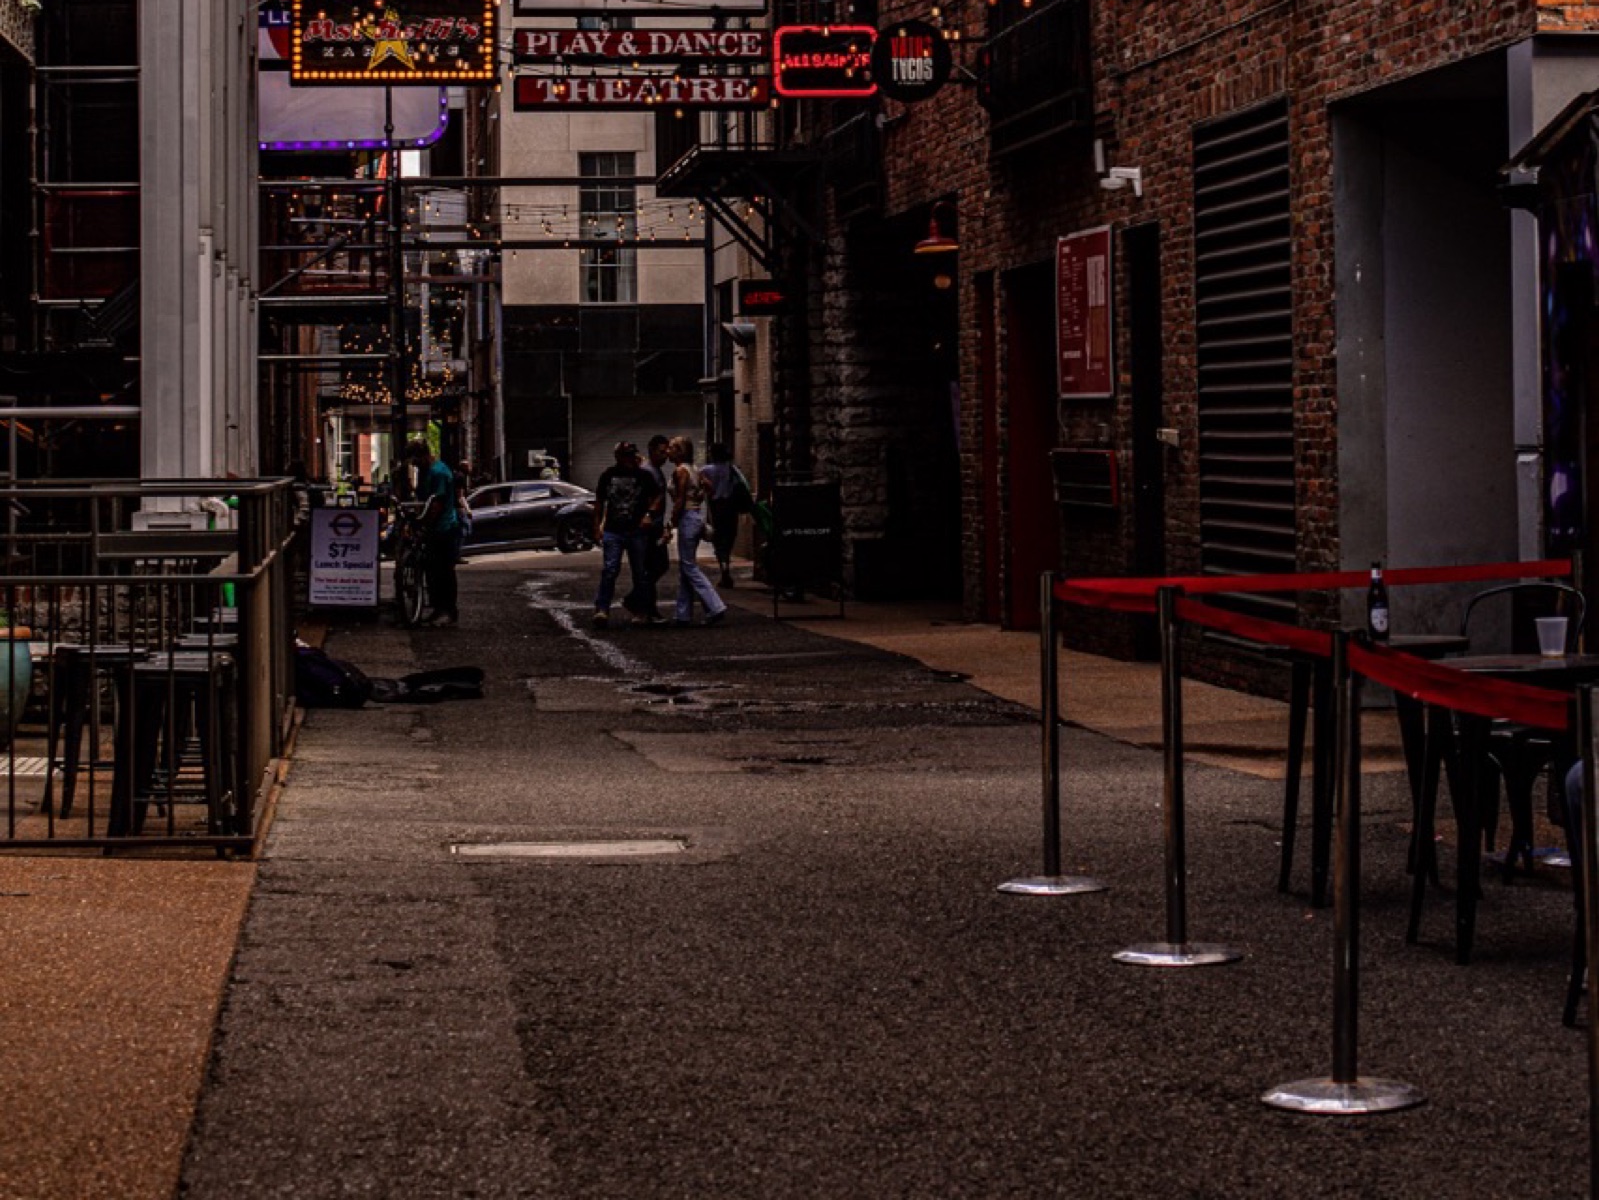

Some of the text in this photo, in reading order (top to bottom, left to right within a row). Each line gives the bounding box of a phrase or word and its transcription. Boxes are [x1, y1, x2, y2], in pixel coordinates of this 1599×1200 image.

[525, 31, 763, 56] PLAY & DANCE
[536, 78, 752, 103] THEATRE
